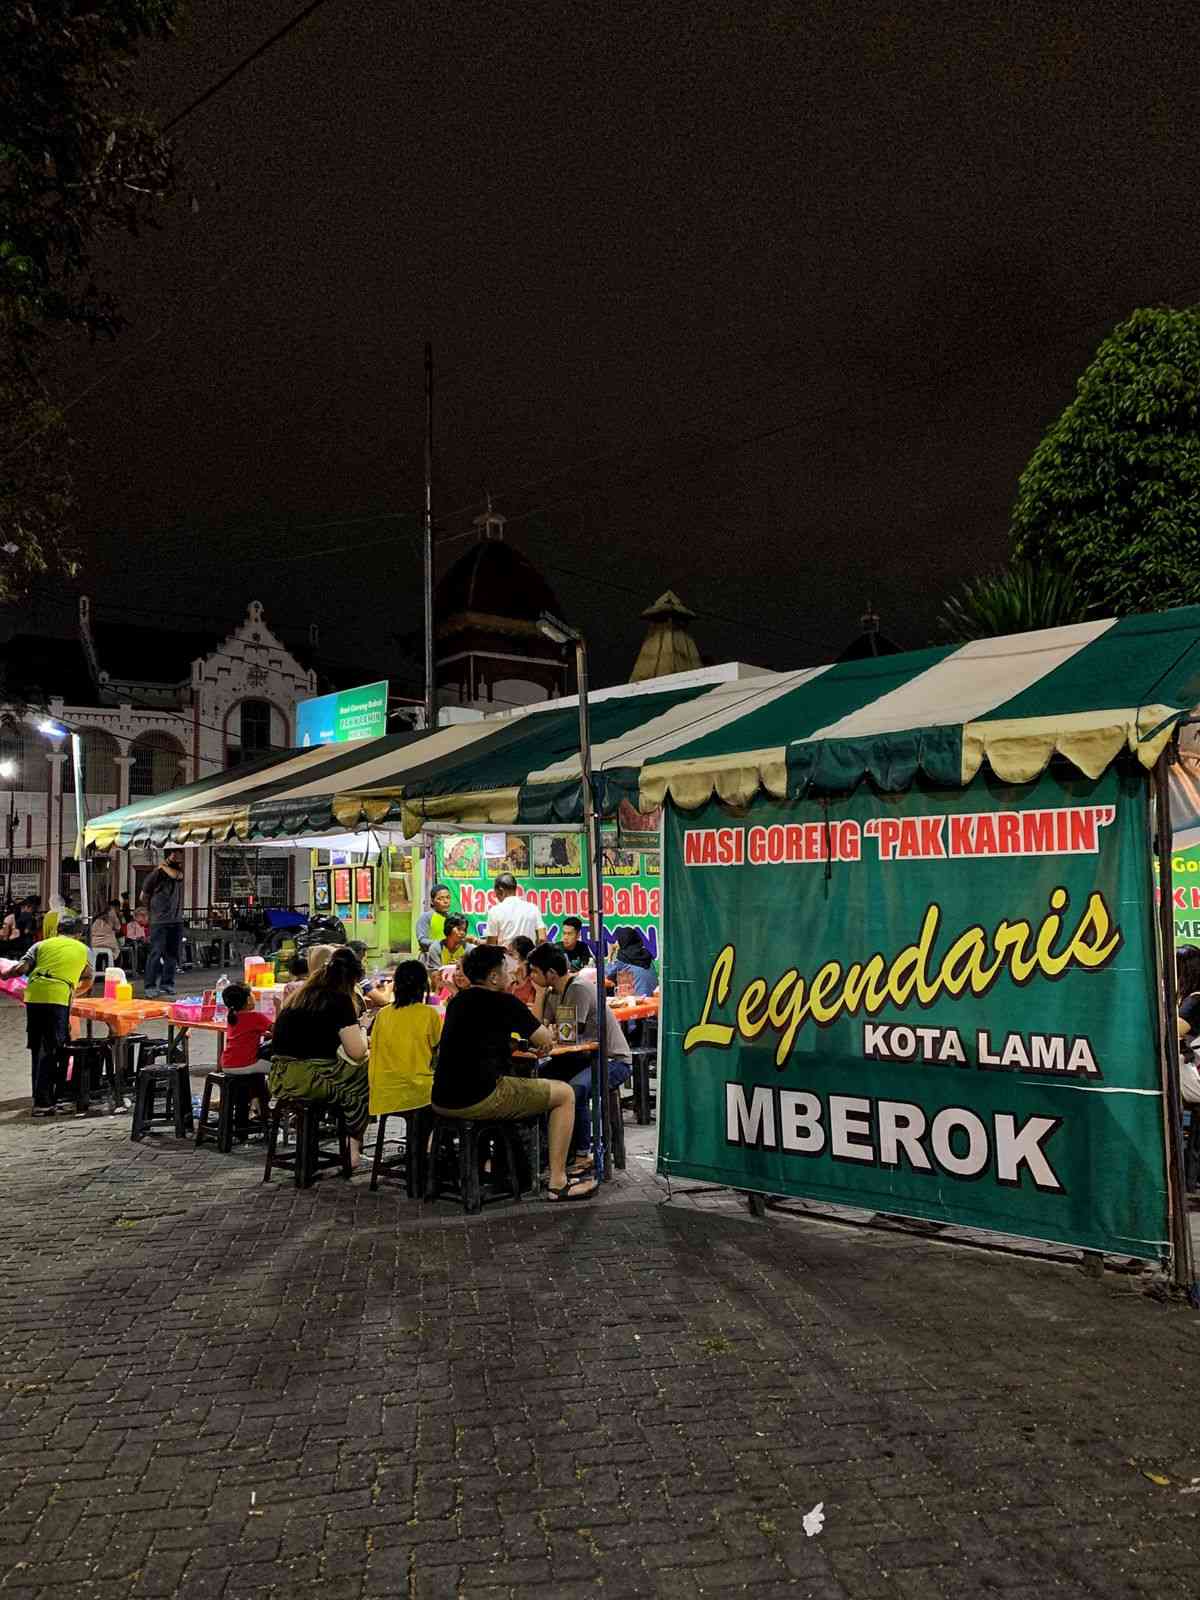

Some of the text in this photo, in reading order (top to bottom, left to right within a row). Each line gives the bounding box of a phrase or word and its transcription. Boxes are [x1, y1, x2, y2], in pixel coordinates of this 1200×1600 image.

[684, 827, 745, 866] NASI
[747, 821, 861, 865] GORENG
[683, 888, 1120, 1067] Legendaris
[863, 1022, 1100, 1075] KOTA LAMA
[724, 1081, 1064, 1191] MBEROK
